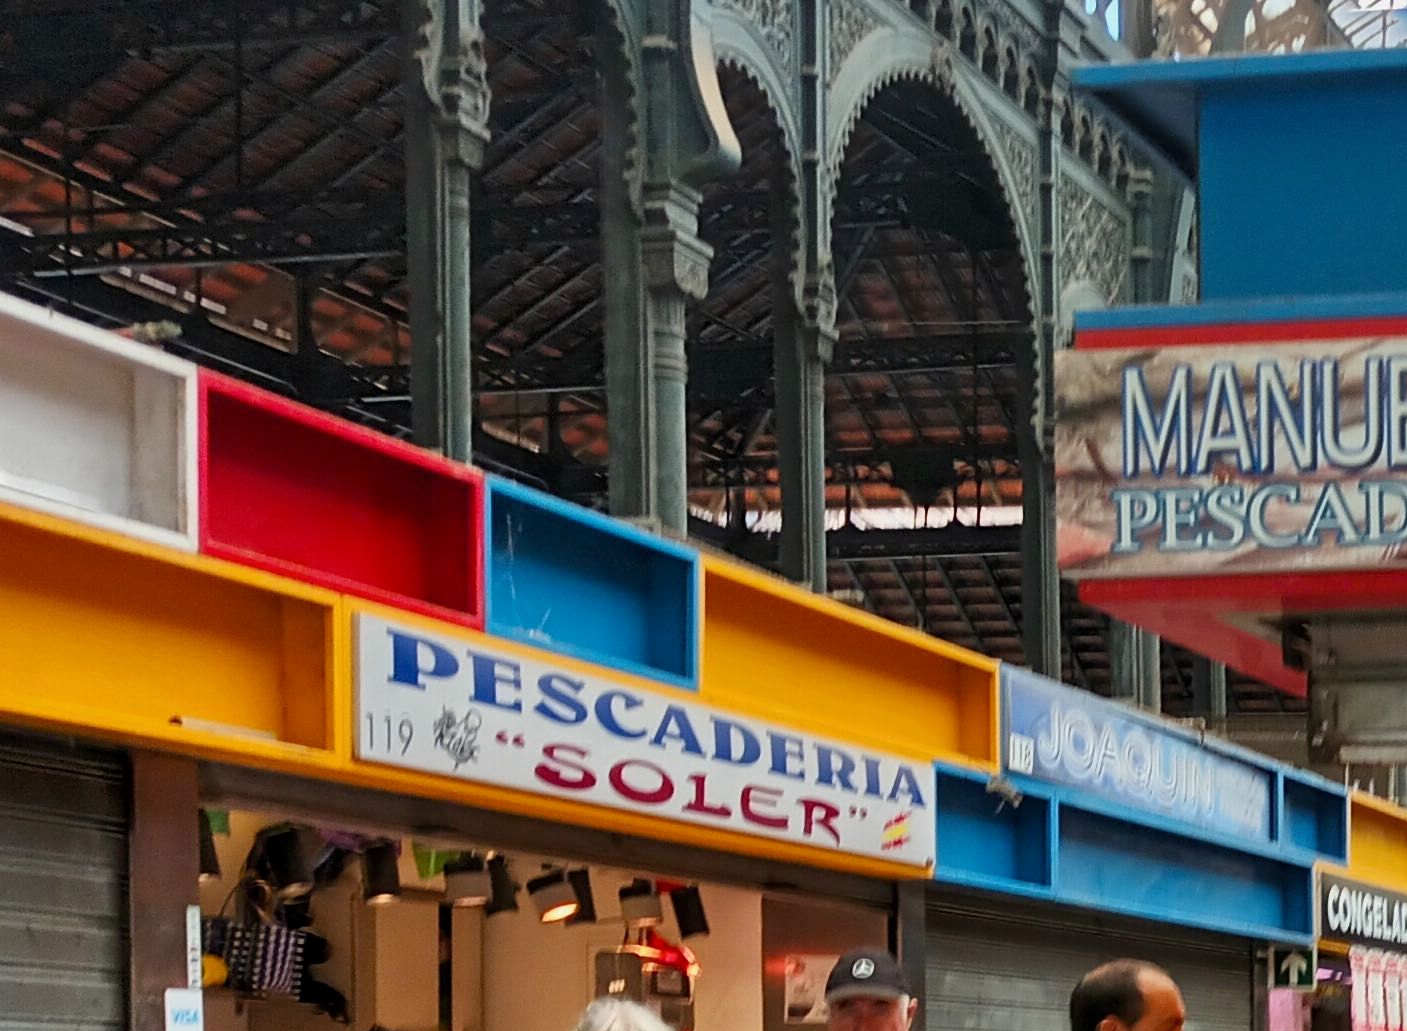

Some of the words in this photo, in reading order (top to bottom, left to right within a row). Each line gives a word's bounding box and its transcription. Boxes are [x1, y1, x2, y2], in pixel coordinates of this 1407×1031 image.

[365, 710, 414, 757] 119
[387, 627, 926, 807] PESCADERIA
[1038, 702, 1217, 817] JOAQUIN
